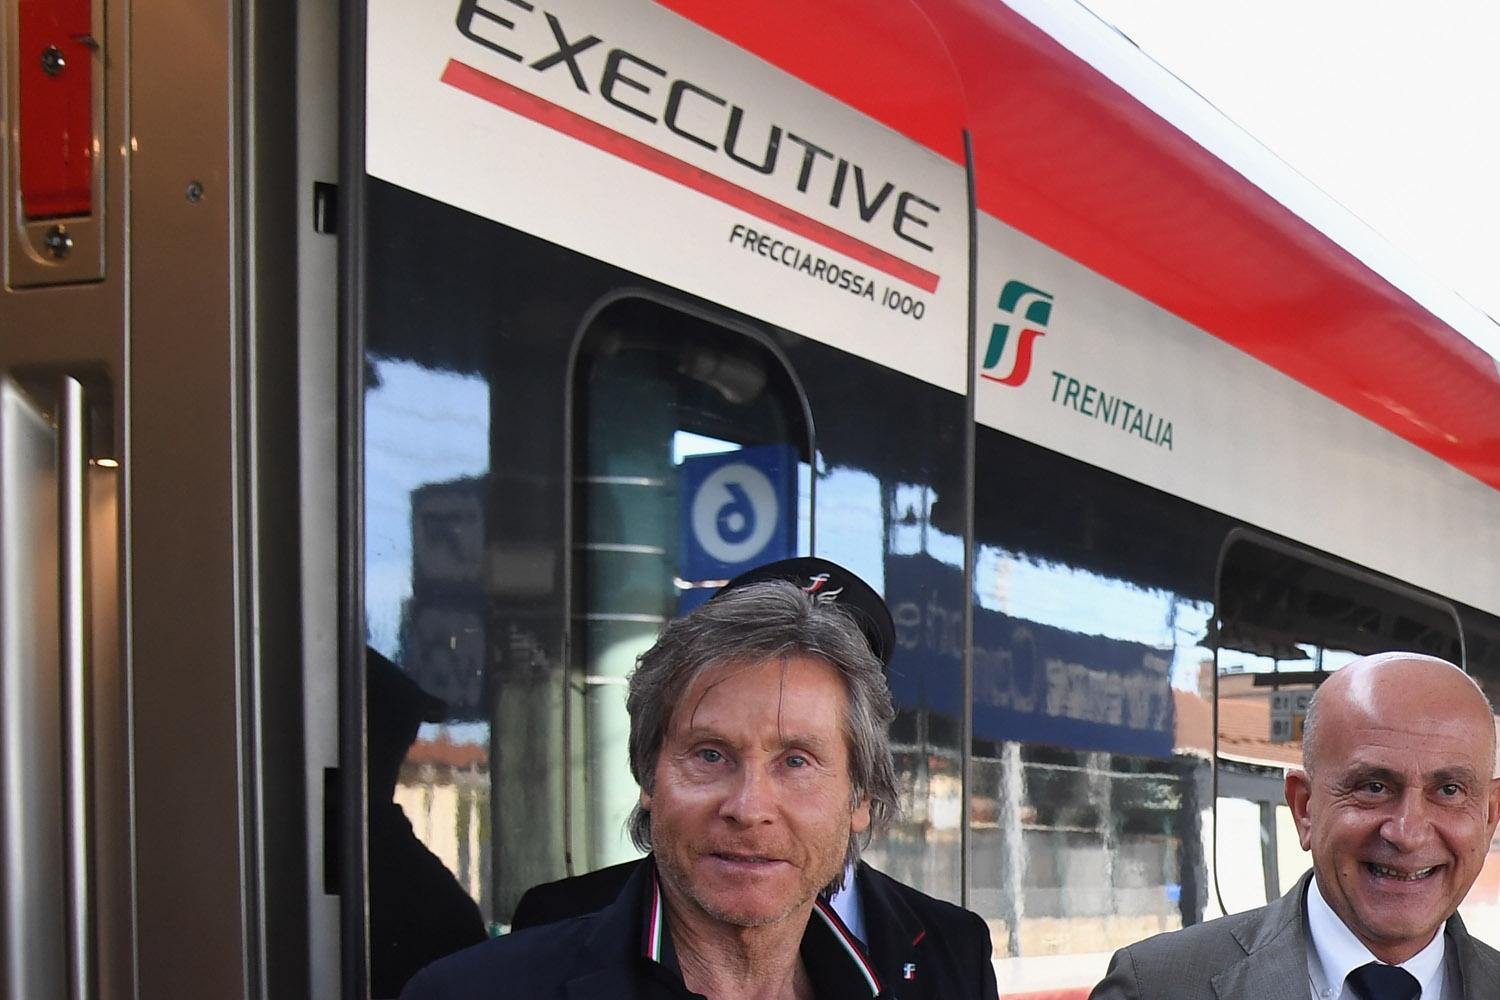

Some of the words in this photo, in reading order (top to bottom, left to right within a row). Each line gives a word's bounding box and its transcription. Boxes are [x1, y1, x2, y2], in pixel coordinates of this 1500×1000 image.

[456, 0, 940, 252] EXECUTIVE
[729, 225, 875, 300] FRECCIAROSSA
[884, 286, 926, 320] 1000
[1052, 370, 1174, 452] TRENITALIA
